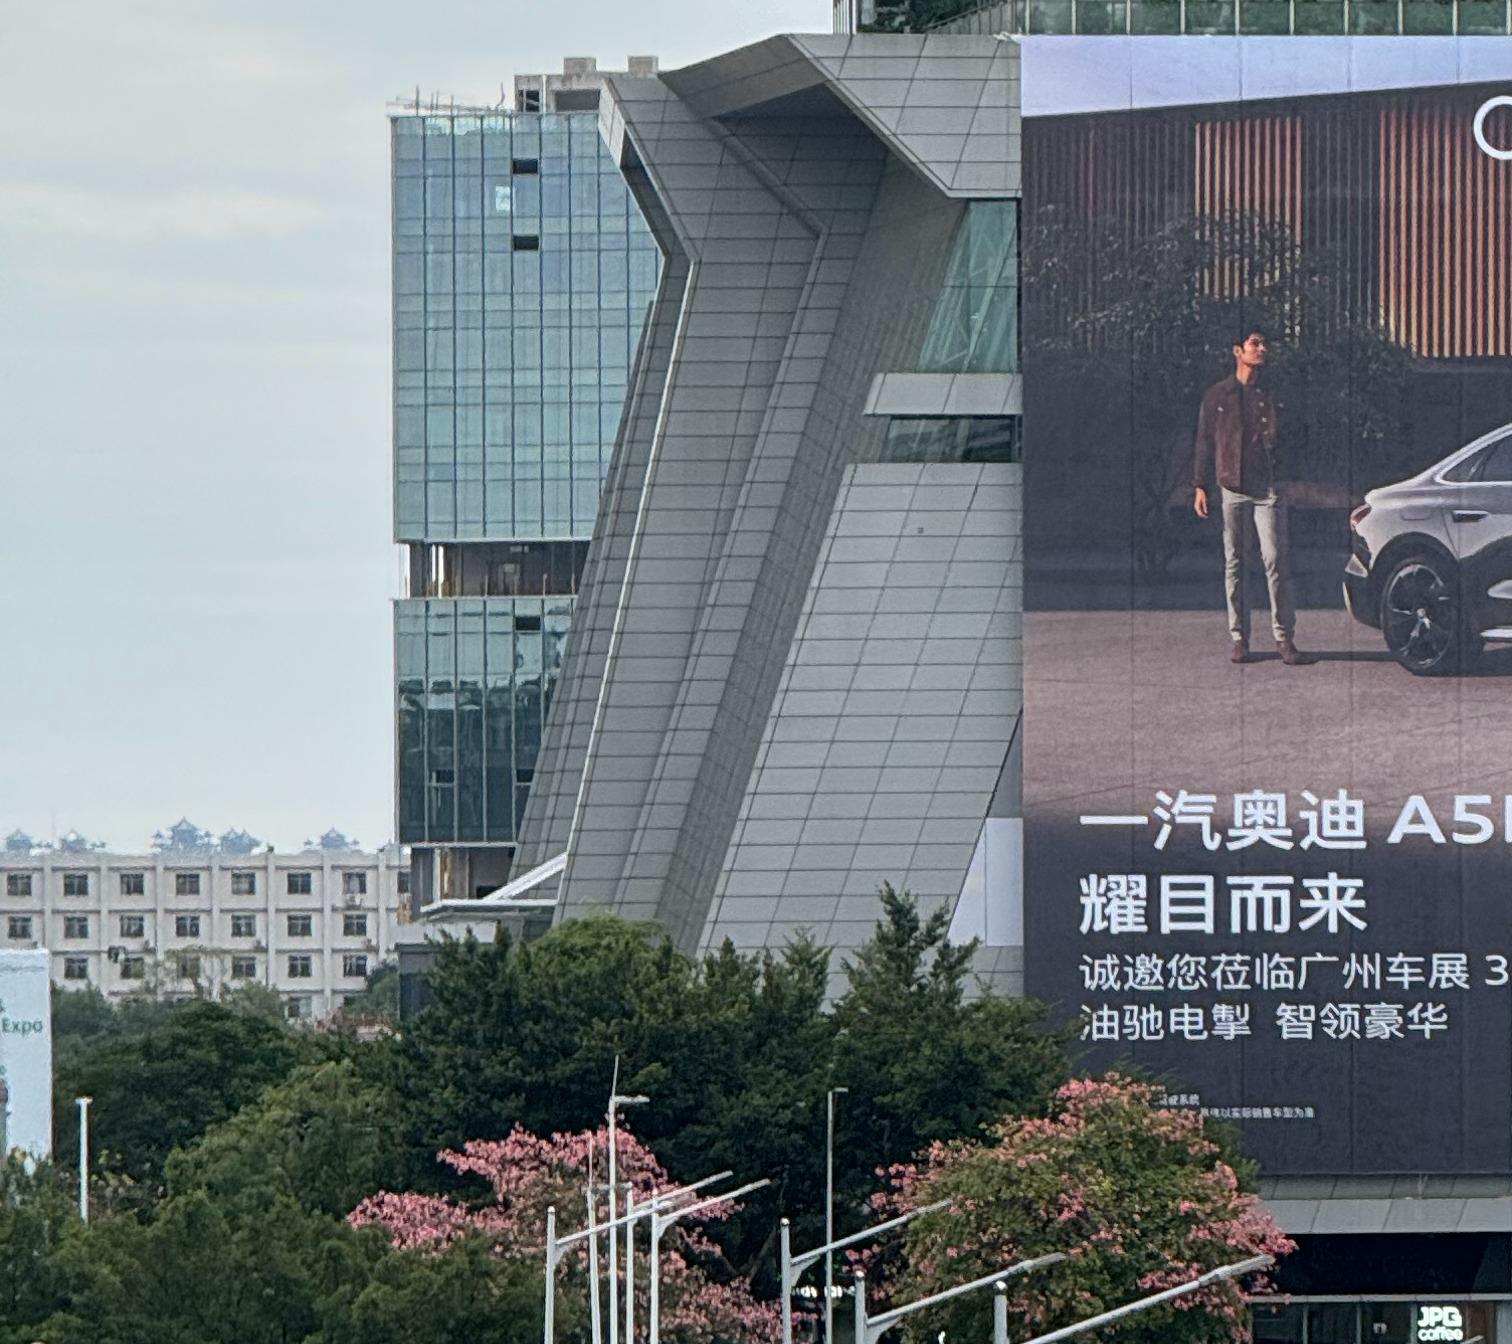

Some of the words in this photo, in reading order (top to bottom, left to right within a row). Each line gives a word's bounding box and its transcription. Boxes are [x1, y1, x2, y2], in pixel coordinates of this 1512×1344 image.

[1079, 788, 1368, 852] 一汽奥迪
[1079, 871, 1368, 936] 耀目而来
[1078, 951, 1471, 992] 诚邀您莅临广州车展
[1079, 1002, 1252, 1042] 油驰电掣
[1275, 1001, 1448, 1042] 智领豪华
